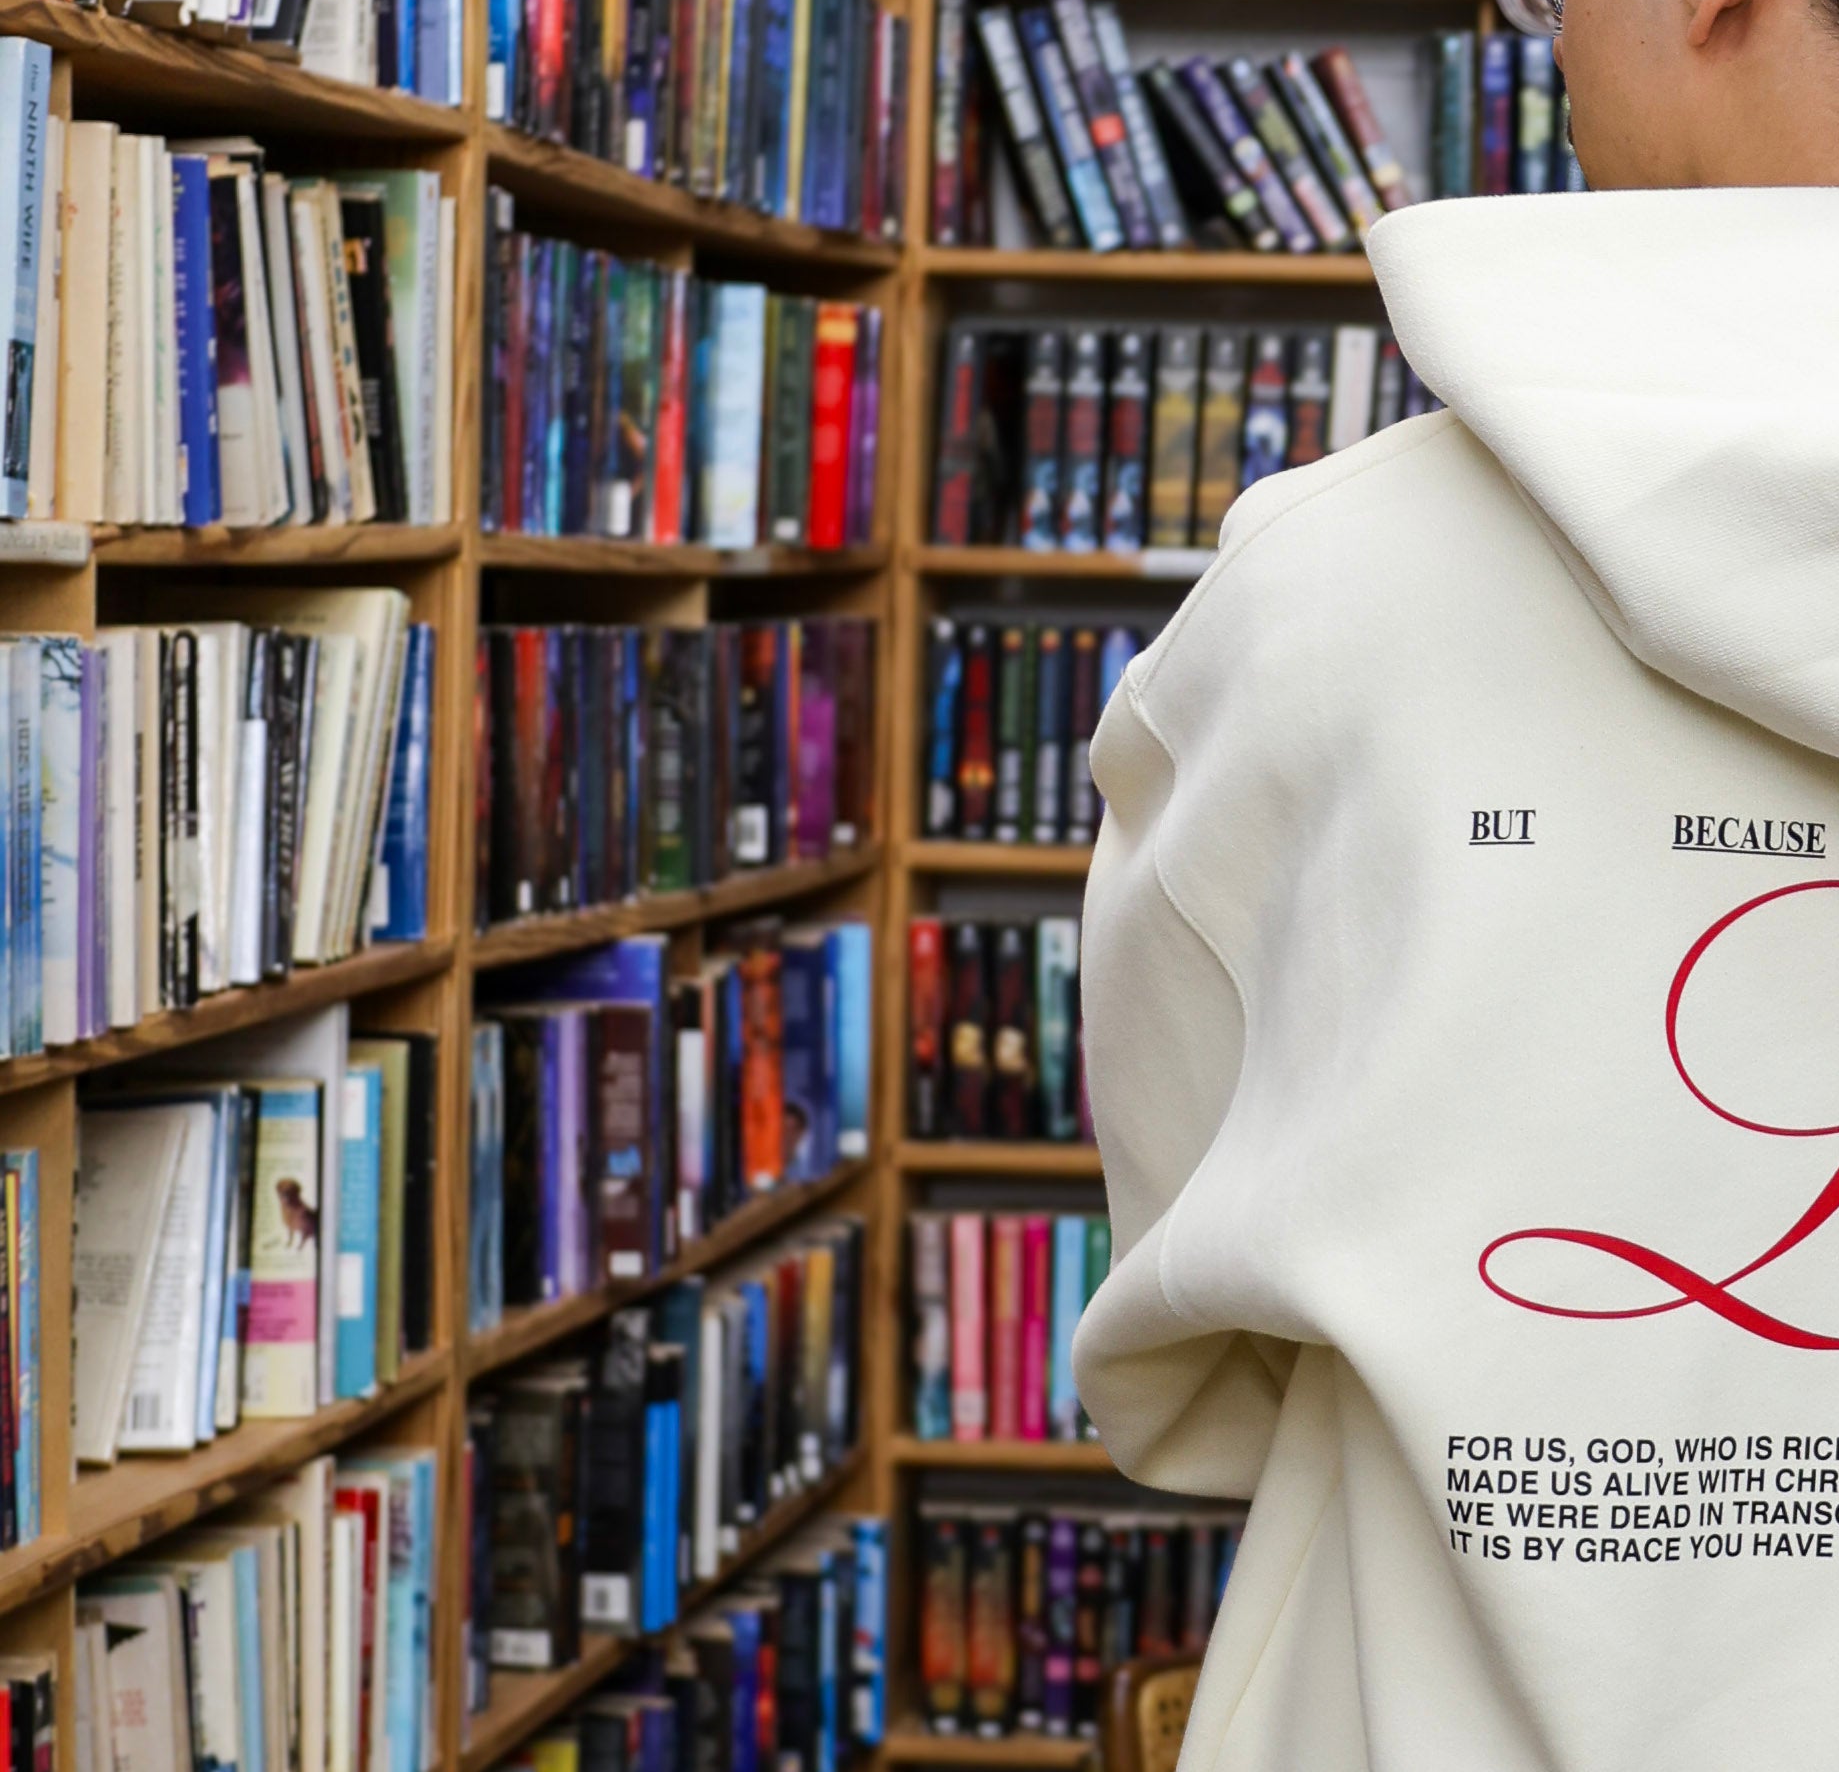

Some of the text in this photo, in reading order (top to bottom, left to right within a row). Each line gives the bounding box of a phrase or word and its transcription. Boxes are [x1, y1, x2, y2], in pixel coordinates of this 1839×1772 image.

[25, 99, 39, 192] NINTH
[21, 202, 36, 271] WIFE
[1470, 809, 1536, 845] BUT
[1672, 814, 1826, 859] BECAUSE
[1448, 1435, 1513, 1461] FOR
[1525, 1437, 1576, 1467] US,
[1587, 1438, 1665, 1468] GOD,
[1675, 1436, 1737, 1463] WHO
[1746, 1435, 1773, 1461] IS
[1447, 1467, 1539, 1495] MADE
[1551, 1471, 1592, 1497] US
[1602, 1471, 1689, 1497] ALIVE
[1698, 1468, 1765, 1494] WITH
[1446, 1498, 1494, 1527] WE
[1506, 1503, 1599, 1529] WERE
[1610, 1504, 1691, 1530] DEAD
[1699, 1501, 1724, 1527] IN
[1449, 1528, 1473, 1554] IT
[1483, 1534, 1511, 1560] IS
[1523, 1536, 1565, 1562] BY
[1575, 1537, 1681, 1563] GRACE
[1690, 1533, 1743, 1559] YOU
[1752, 1533, 1834, 1558] HAVE
